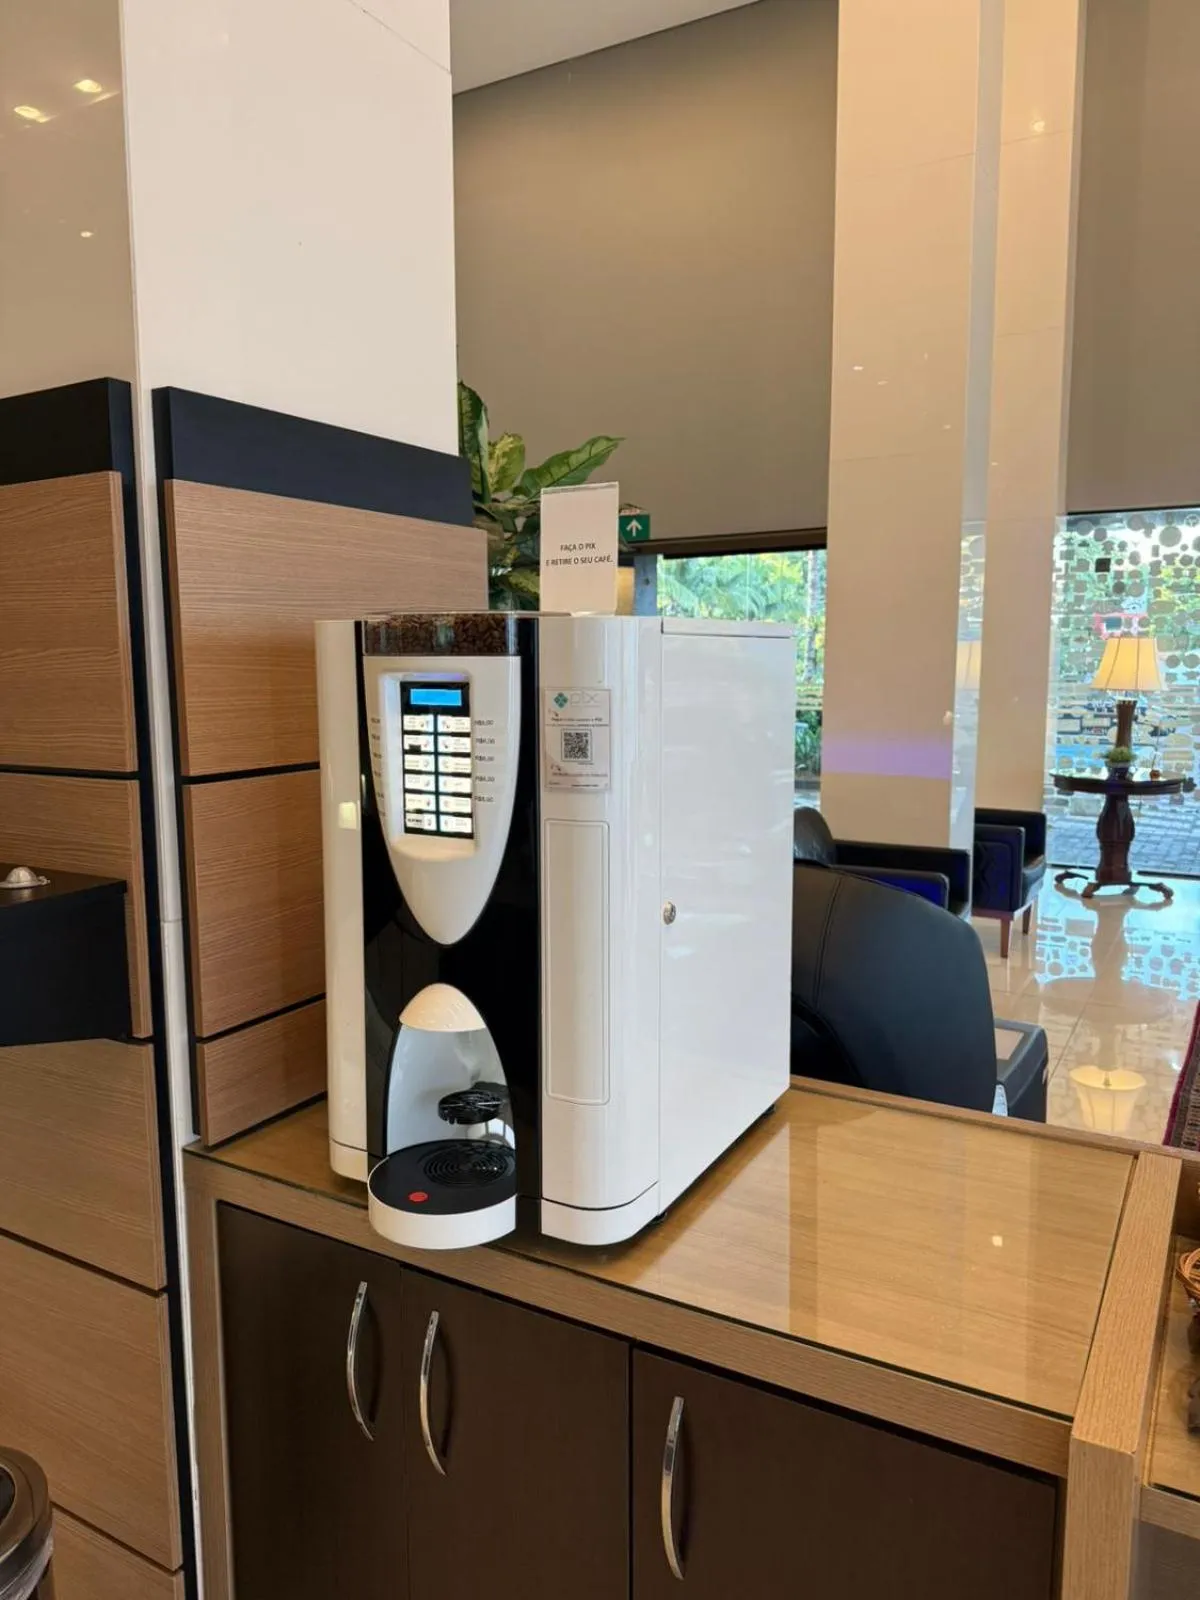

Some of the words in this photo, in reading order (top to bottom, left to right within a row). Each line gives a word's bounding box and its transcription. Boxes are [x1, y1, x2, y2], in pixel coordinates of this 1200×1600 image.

[560, 544, 577, 552] FAÇA
[551, 558, 572, 566] RETIRE
[580, 556, 593, 564] SEU
